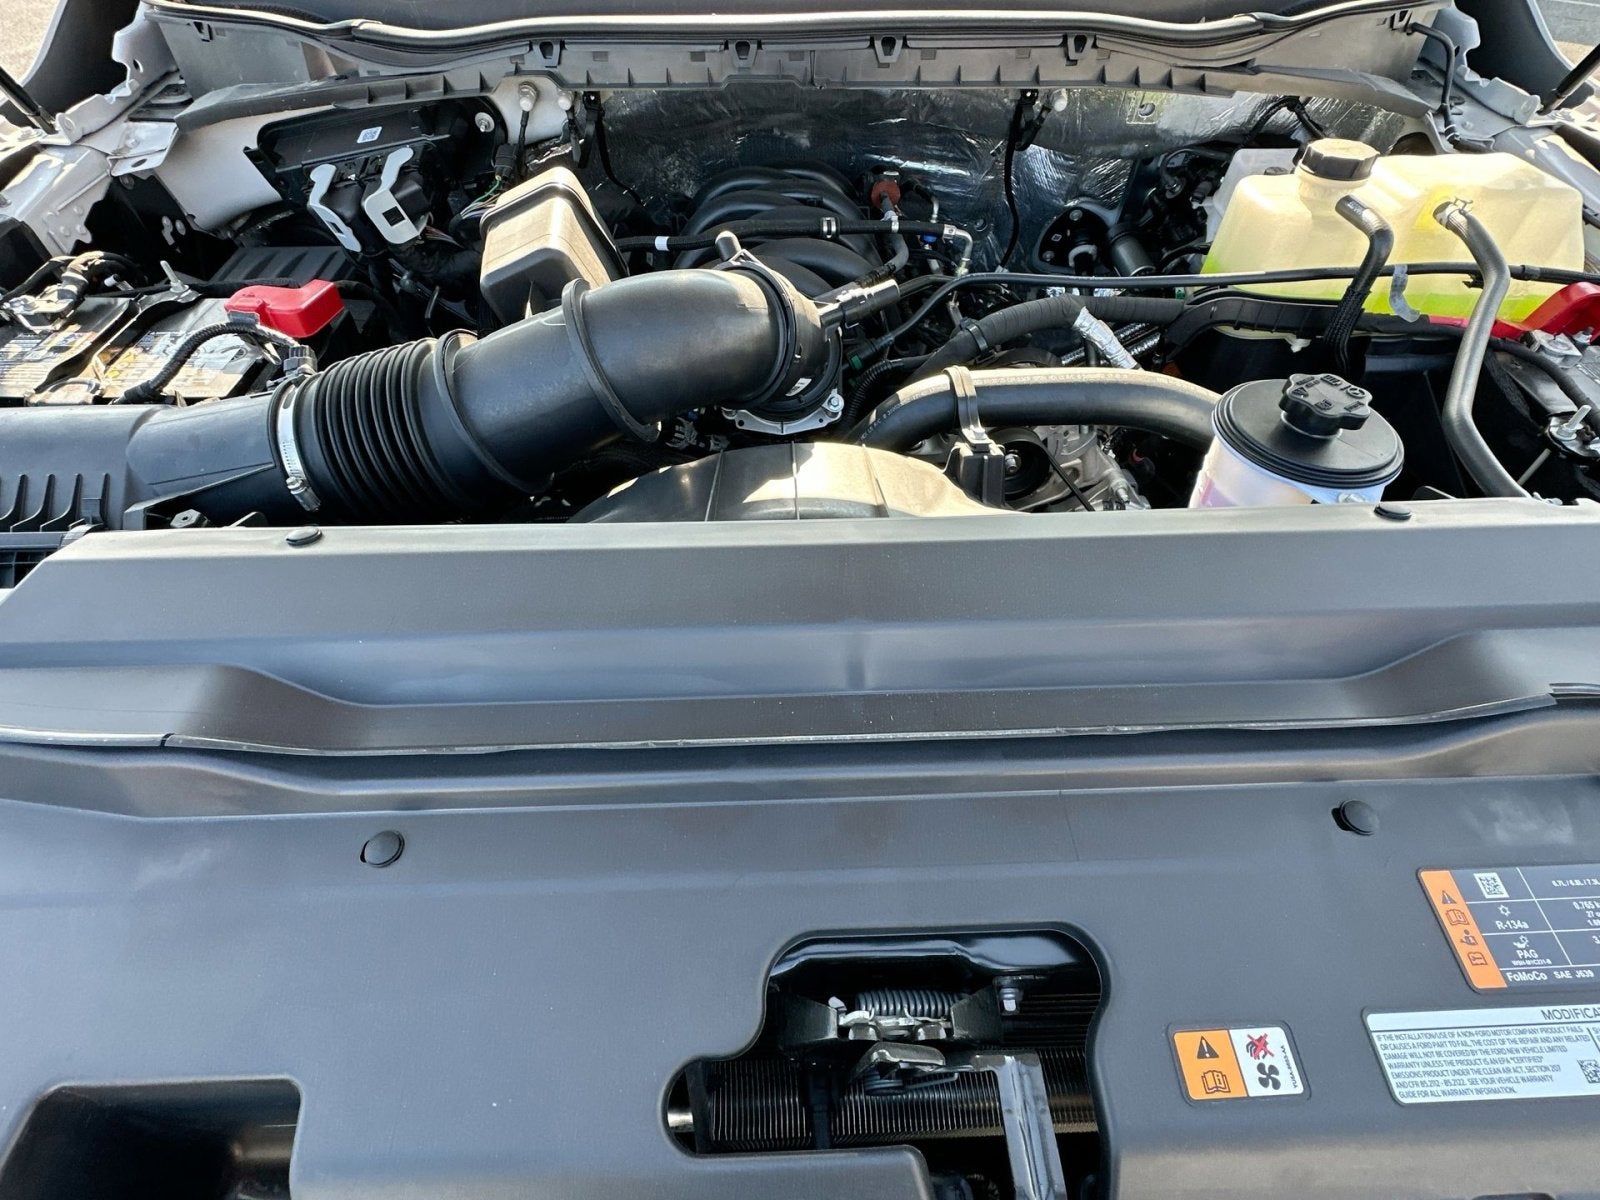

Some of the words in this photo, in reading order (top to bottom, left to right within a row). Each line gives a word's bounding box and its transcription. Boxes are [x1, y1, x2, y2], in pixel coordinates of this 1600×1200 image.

[1495, 920, 1529, 930] R-134a
[1516, 949, 1538, 959] PAG
[1506, 970, 1548, 982] FoMoCo
[1553, 970, 1573, 979] SAE
[1575, 969, 1594, 978] J639
[1391, 1071, 1422, 1079] EMISSIONS
[1520, 1075, 1554, 1083] WARRANTY
[1441, 1088, 1475, 1096] WARRANTY
